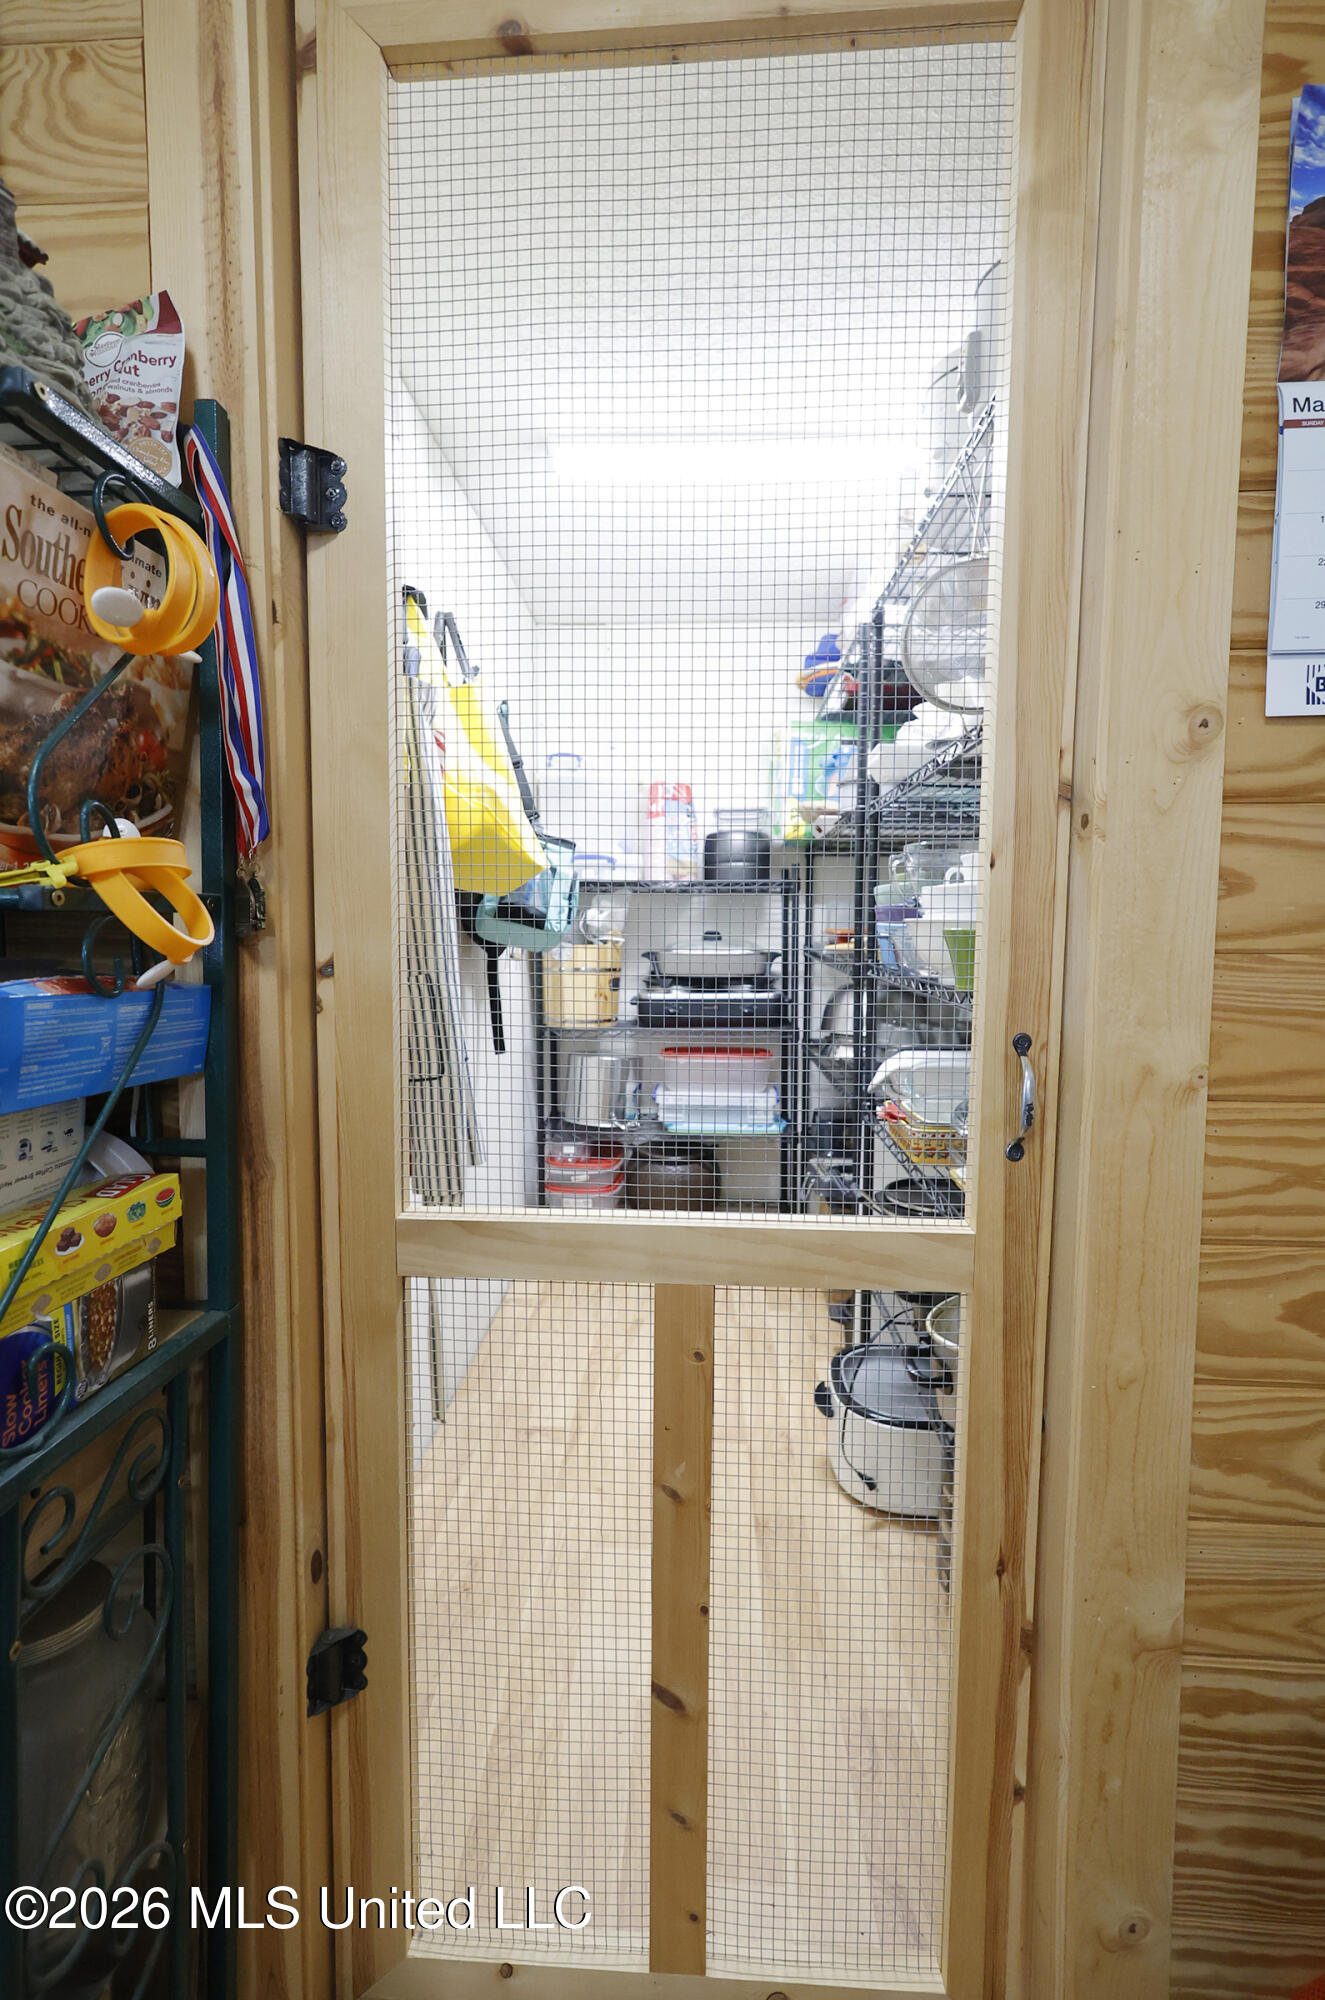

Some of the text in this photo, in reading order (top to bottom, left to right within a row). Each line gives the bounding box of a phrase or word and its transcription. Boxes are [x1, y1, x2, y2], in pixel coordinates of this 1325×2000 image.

[86, 368, 111, 387] erry
[1292, 396, 1325, 413] Ma
[30, 494, 55, 516] the
[61, 512, 91, 537] all-n
[2, 504, 86, 596] Southe
[147, 1301, 158, 1351] 8 LINERS
[33, 1359, 48, 1428] Liners
[2, 1393, 18, 1448] Slow
